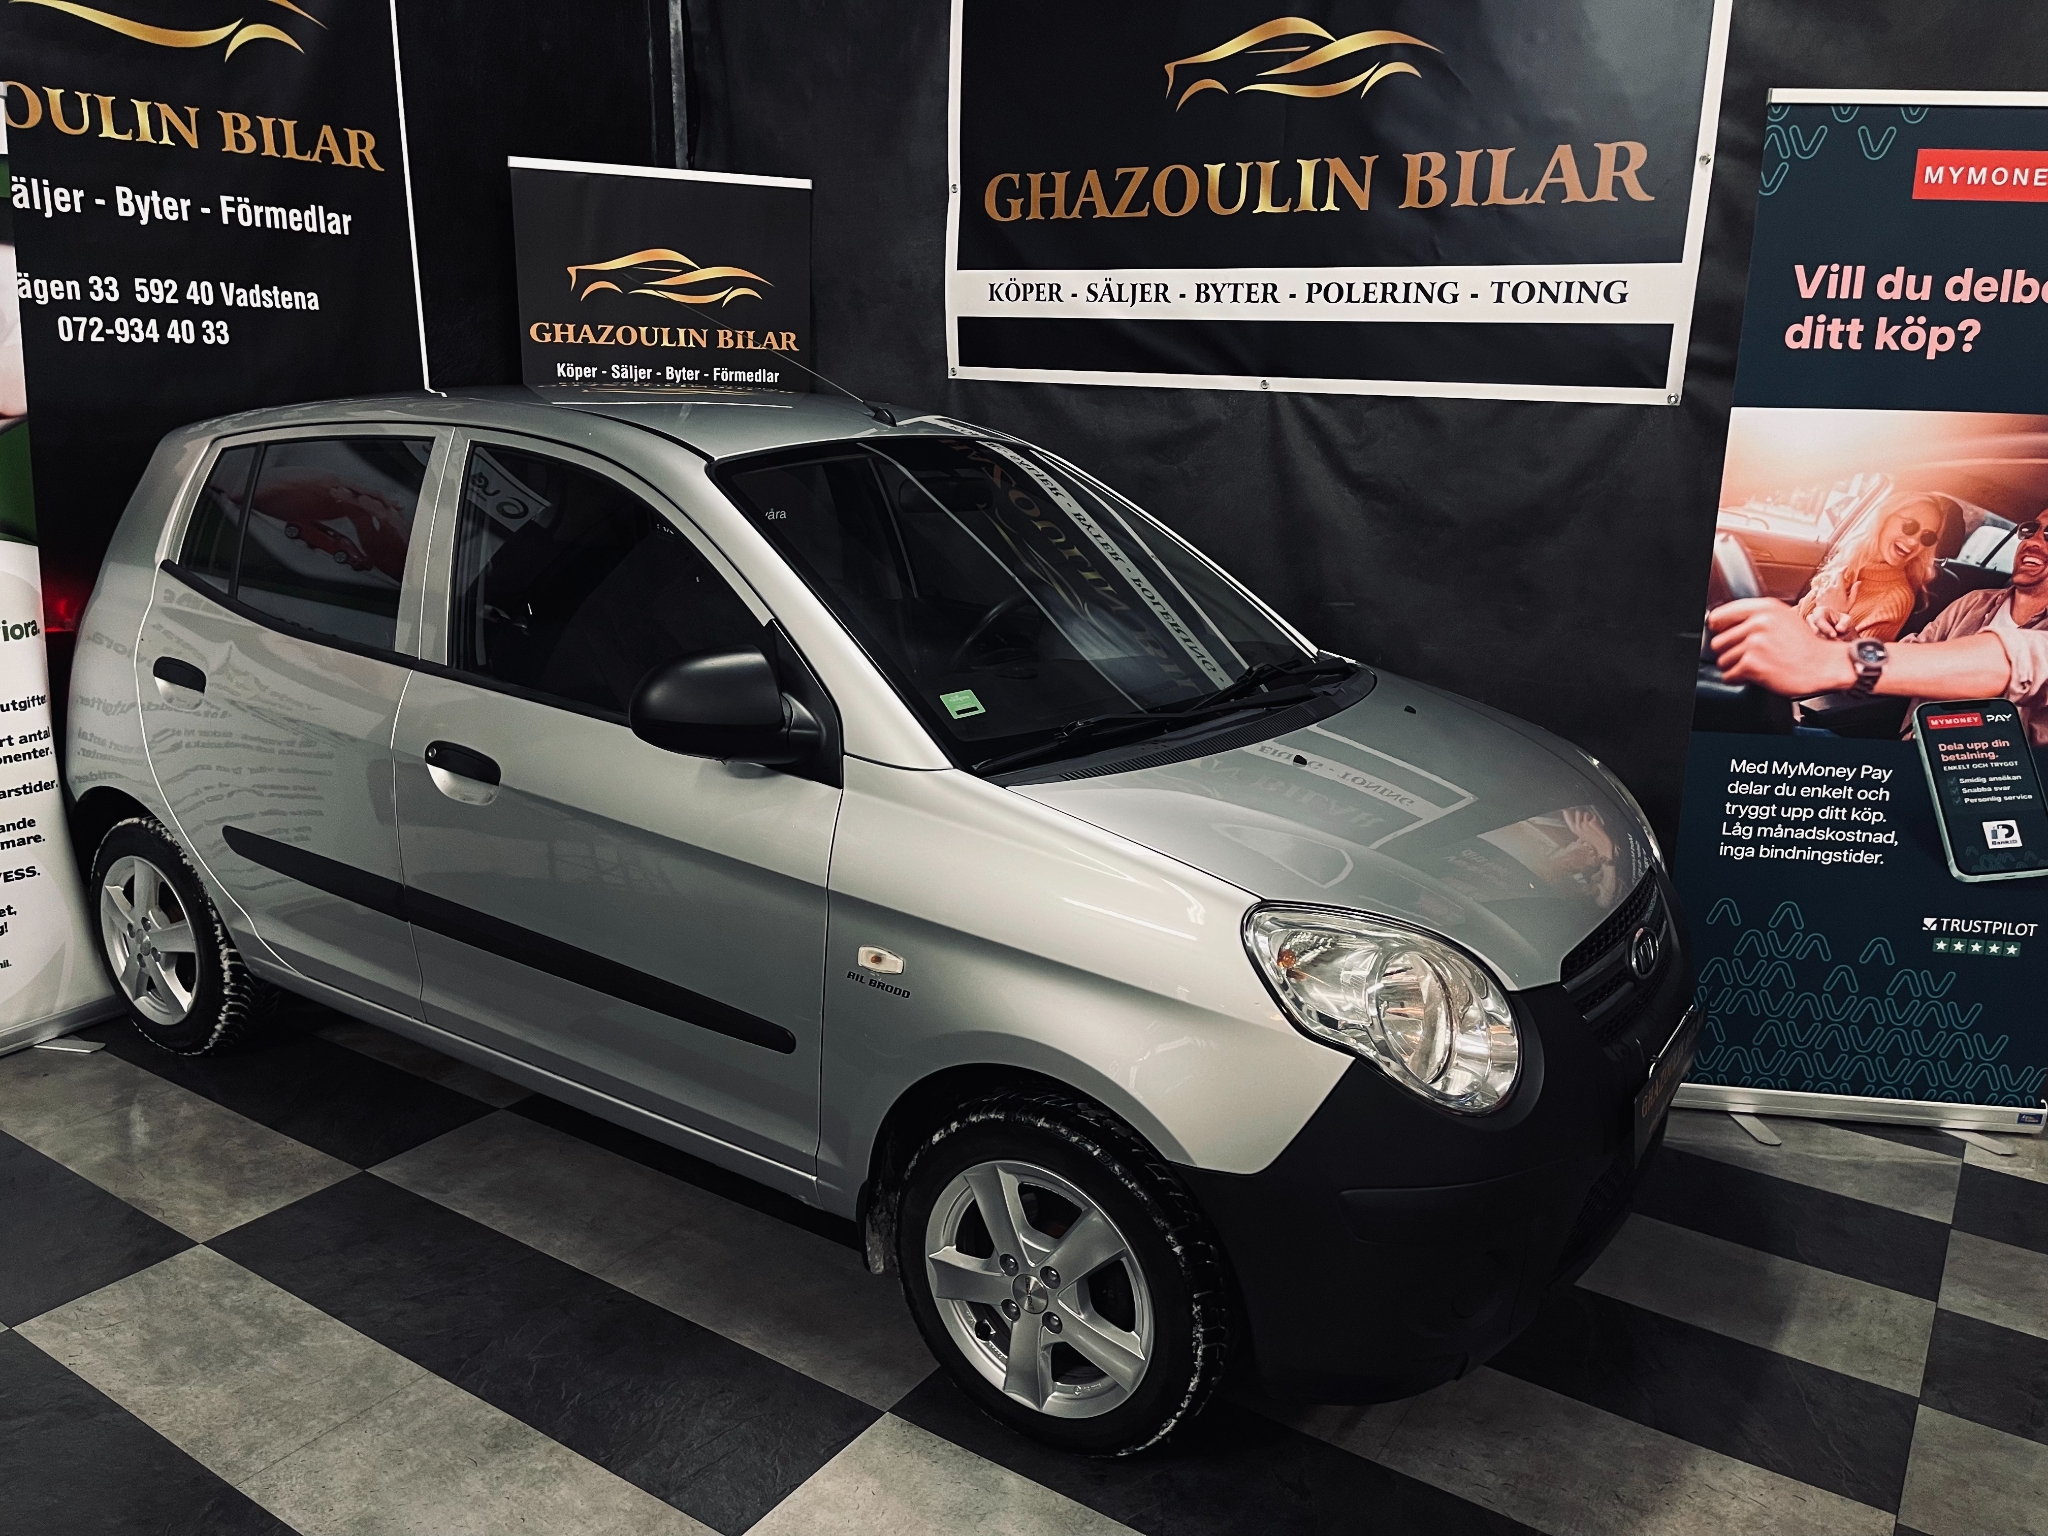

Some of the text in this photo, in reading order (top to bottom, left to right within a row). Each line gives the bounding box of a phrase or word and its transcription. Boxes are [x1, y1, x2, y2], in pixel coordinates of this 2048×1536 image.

[217, 110, 385, 172] BILAR
[984, 140, 1655, 222] GHAZOULIN BILAR
[1923, 166, 2048, 187] MYMONE
[11, 175, 84, 218] äljer
[115, 185, 191, 225] Byter
[219, 194, 352, 236] Förmedlar
[988, 277, 1064, 303] KÖPER
[1086, 277, 1171, 308] SÄLJER
[1194, 282, 1281, 304] BYTER
[1305, 281, 1460, 305] POLERING
[1490, 280, 1629, 305] TONING
[1794, 263, 1865, 299] Vill
[1876, 266, 1933, 301] du
[88, 276, 119, 303] 33
[135, 278, 179, 305] 592
[186, 280, 214, 306] 40
[220, 282, 320, 311] Vadstena
[57, 316, 230, 345] 072-934 40 33
[529, 322, 800, 351] GHAZOULIN BILAR
[1784, 314, 1981, 360] ditt köp?
[557, 362, 598, 381] Köper
[611, 364, 653, 384] Säljer
[665, 366, 700, 384] Byter
[713, 367, 780, 383] Förmedlar
[0, 620, 40, 641] iora.
[1930, 714, 2012, 726] MYMONEY PAY
[19, 726, 50, 744] antal
[1938, 739, 2010, 752] Dela upp din
[1941, 751, 1999, 762] betalning.
[1943, 763, 1970, 771] ENKELT
[1990, 760, 2018, 768] TRYGGT
[1730, 759, 1893, 783] Med MyMoney Pay
[1988, 774, 2022, 782] ansökan
[1727, 781, 1890, 802] delar du enkelt och
[1964, 796, 2002, 804] Personlig
[1725, 802, 1887, 824] tryggt upp ditt köp.
[1722, 822, 1899, 846] Låg månadskostnad,
[1719, 842, 1885, 865] inga bindningstider.
[1940, 917, 2039, 938] TRUSTPILOT
